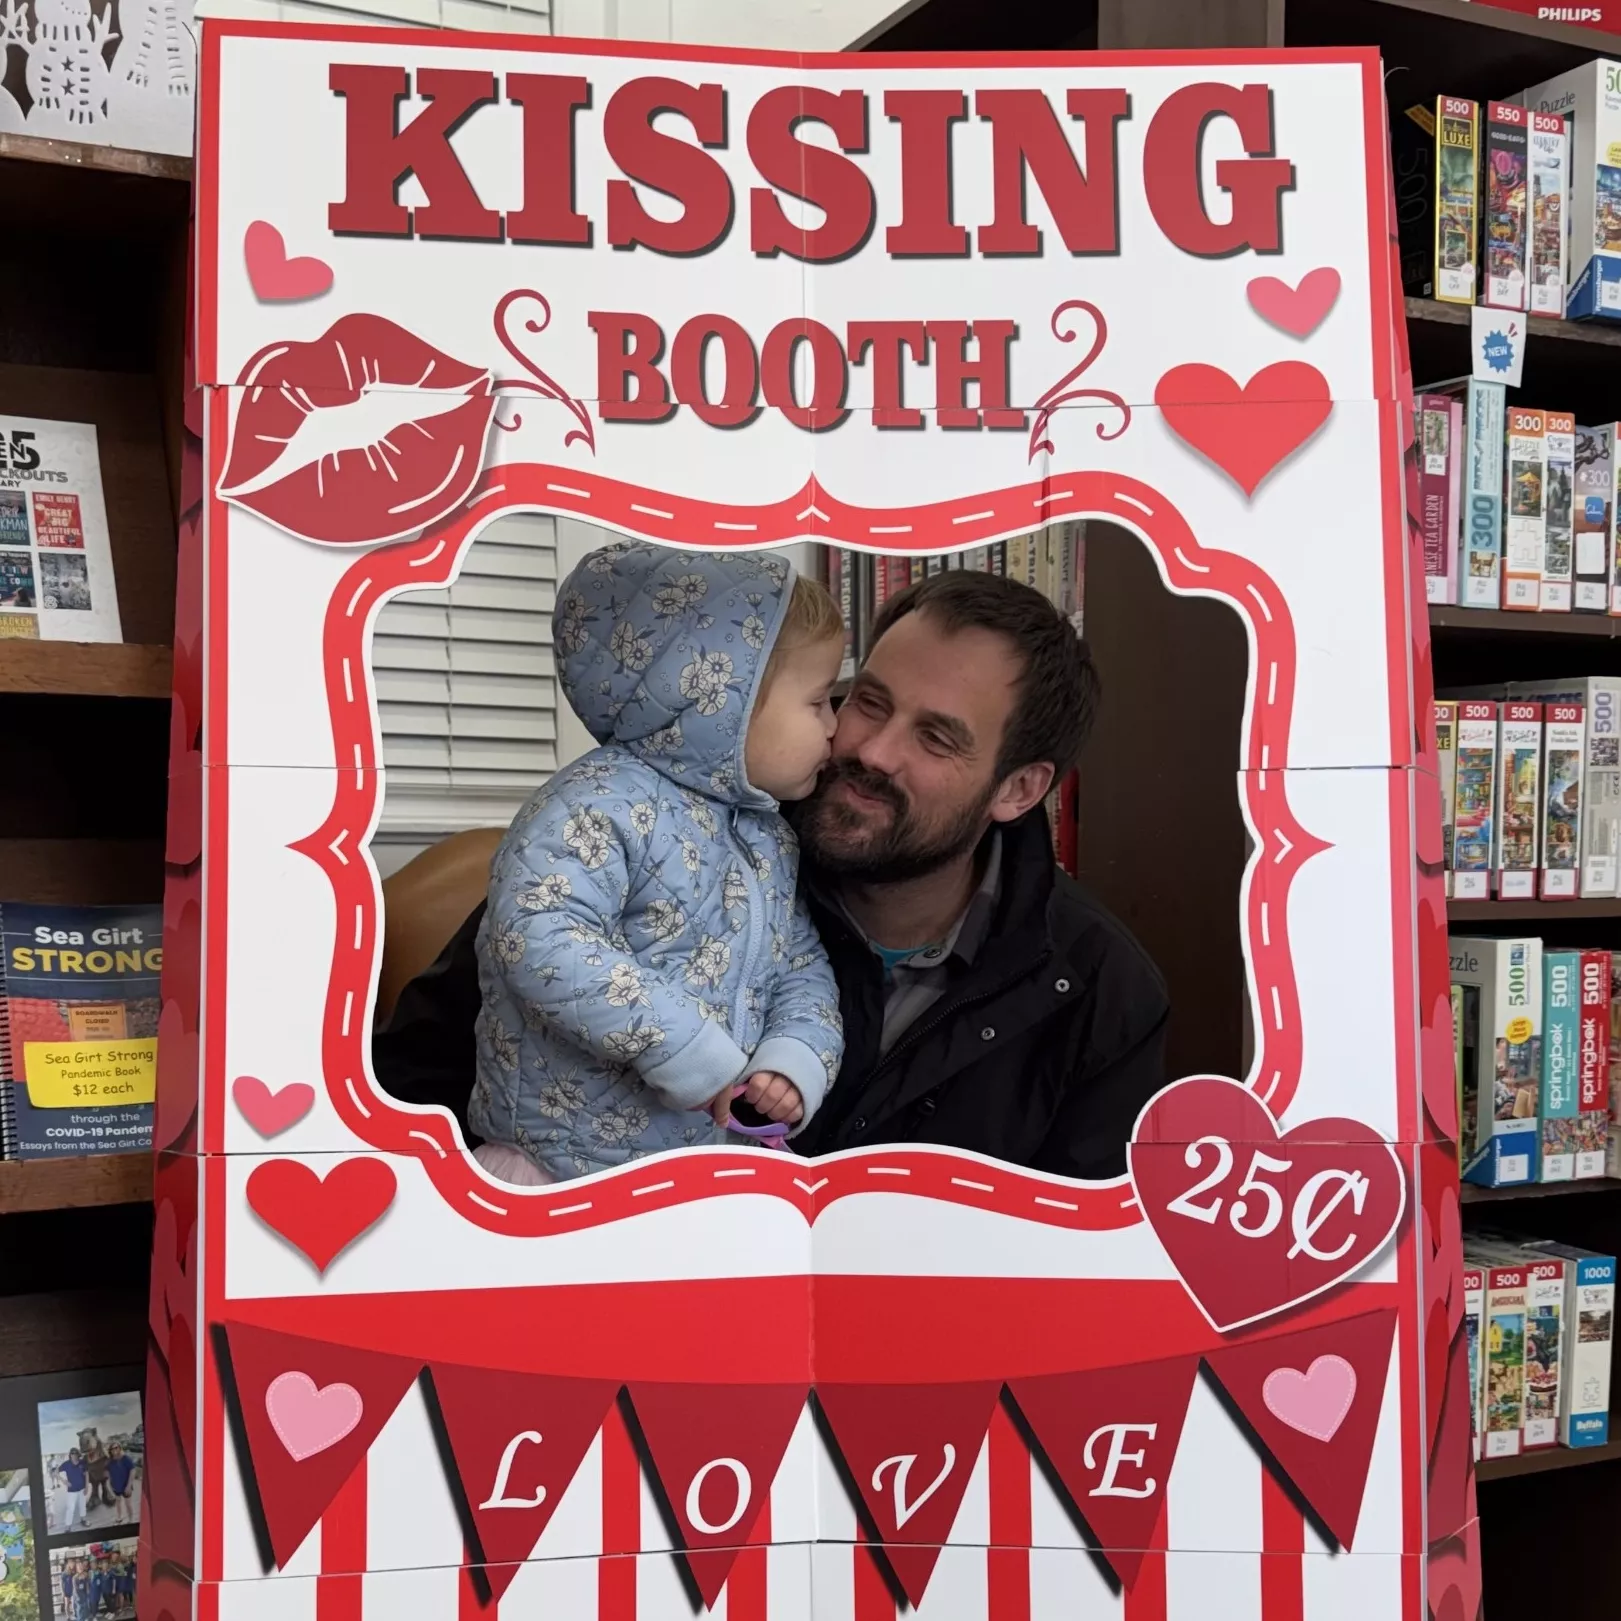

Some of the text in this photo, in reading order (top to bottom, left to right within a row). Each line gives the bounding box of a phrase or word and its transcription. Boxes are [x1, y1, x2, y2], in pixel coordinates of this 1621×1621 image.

[1538, 7, 1602, 22] PHILIPS
[1446, 100, 1469, 115] 500
[1541, 91, 1575, 114] Puzzle
[1497, 107, 1520, 122] 550
[1535, 117, 1559, 131] 500
[1444, 131, 1470, 146] LUXE
[328, 64, 1297, 263] KISSING
[1487, 346, 1508, 357] NEW
[588, 311, 1030, 431] BOOTH
[1515, 415, 1541, 431] 300
[1549, 418, 1572, 431] 300
[0, 430, 41, 470] 5
[0, 468, 69, 483] CKOUTS
[1588, 470, 1610, 487] 300
[0, 480, 21, 488] ARY
[1425, 494, 1439, 529] GARDEN
[0, 517, 28, 530] KMAN
[1471, 496, 1494, 548] 300
[1425, 532, 1438, 547] TEA
[1027, 547, 1036, 586] TRIA
[1424, 551, 1438, 576] ANESE
[842, 577, 852, 630] PEOPLE
[1435, 707, 1449, 719] 00
[1466, 705, 1490, 718] 500
[1511, 707, 1534, 719] 500
[1554, 708, 1576, 720] 500
[1595, 691, 1612, 733] 500
[1437, 737, 1450, 748] XE
[34, 926, 143, 945] Sea Girt
[12, 947, 163, 973] STRONG
[1449, 952, 1479, 972] zzle
[1509, 967, 1525, 1006] 500
[1552, 965, 1568, 1007] 500
[1584, 963, 1599, 1005] 500
[45, 1050, 154, 1064] Sea Girt Strong
[1581, 1017, 1597, 1104] springbok
[61, 1066, 141, 1079] Pandemic Book
[1549, 1023, 1566, 1110] springbok
[73, 1081, 134, 1096] $12 each
[71, 1112, 140, 1124] through the
[45, 1127, 103, 1137] COVID-19
[20, 1138, 153, 1151] Essays from the Sea Girt Co
[1533, 1265, 1556, 1278] 500
[1584, 1266, 1611, 1279] 1000
[1464, 1277, 1479, 1288] 00
[1496, 1273, 1520, 1286] 500
